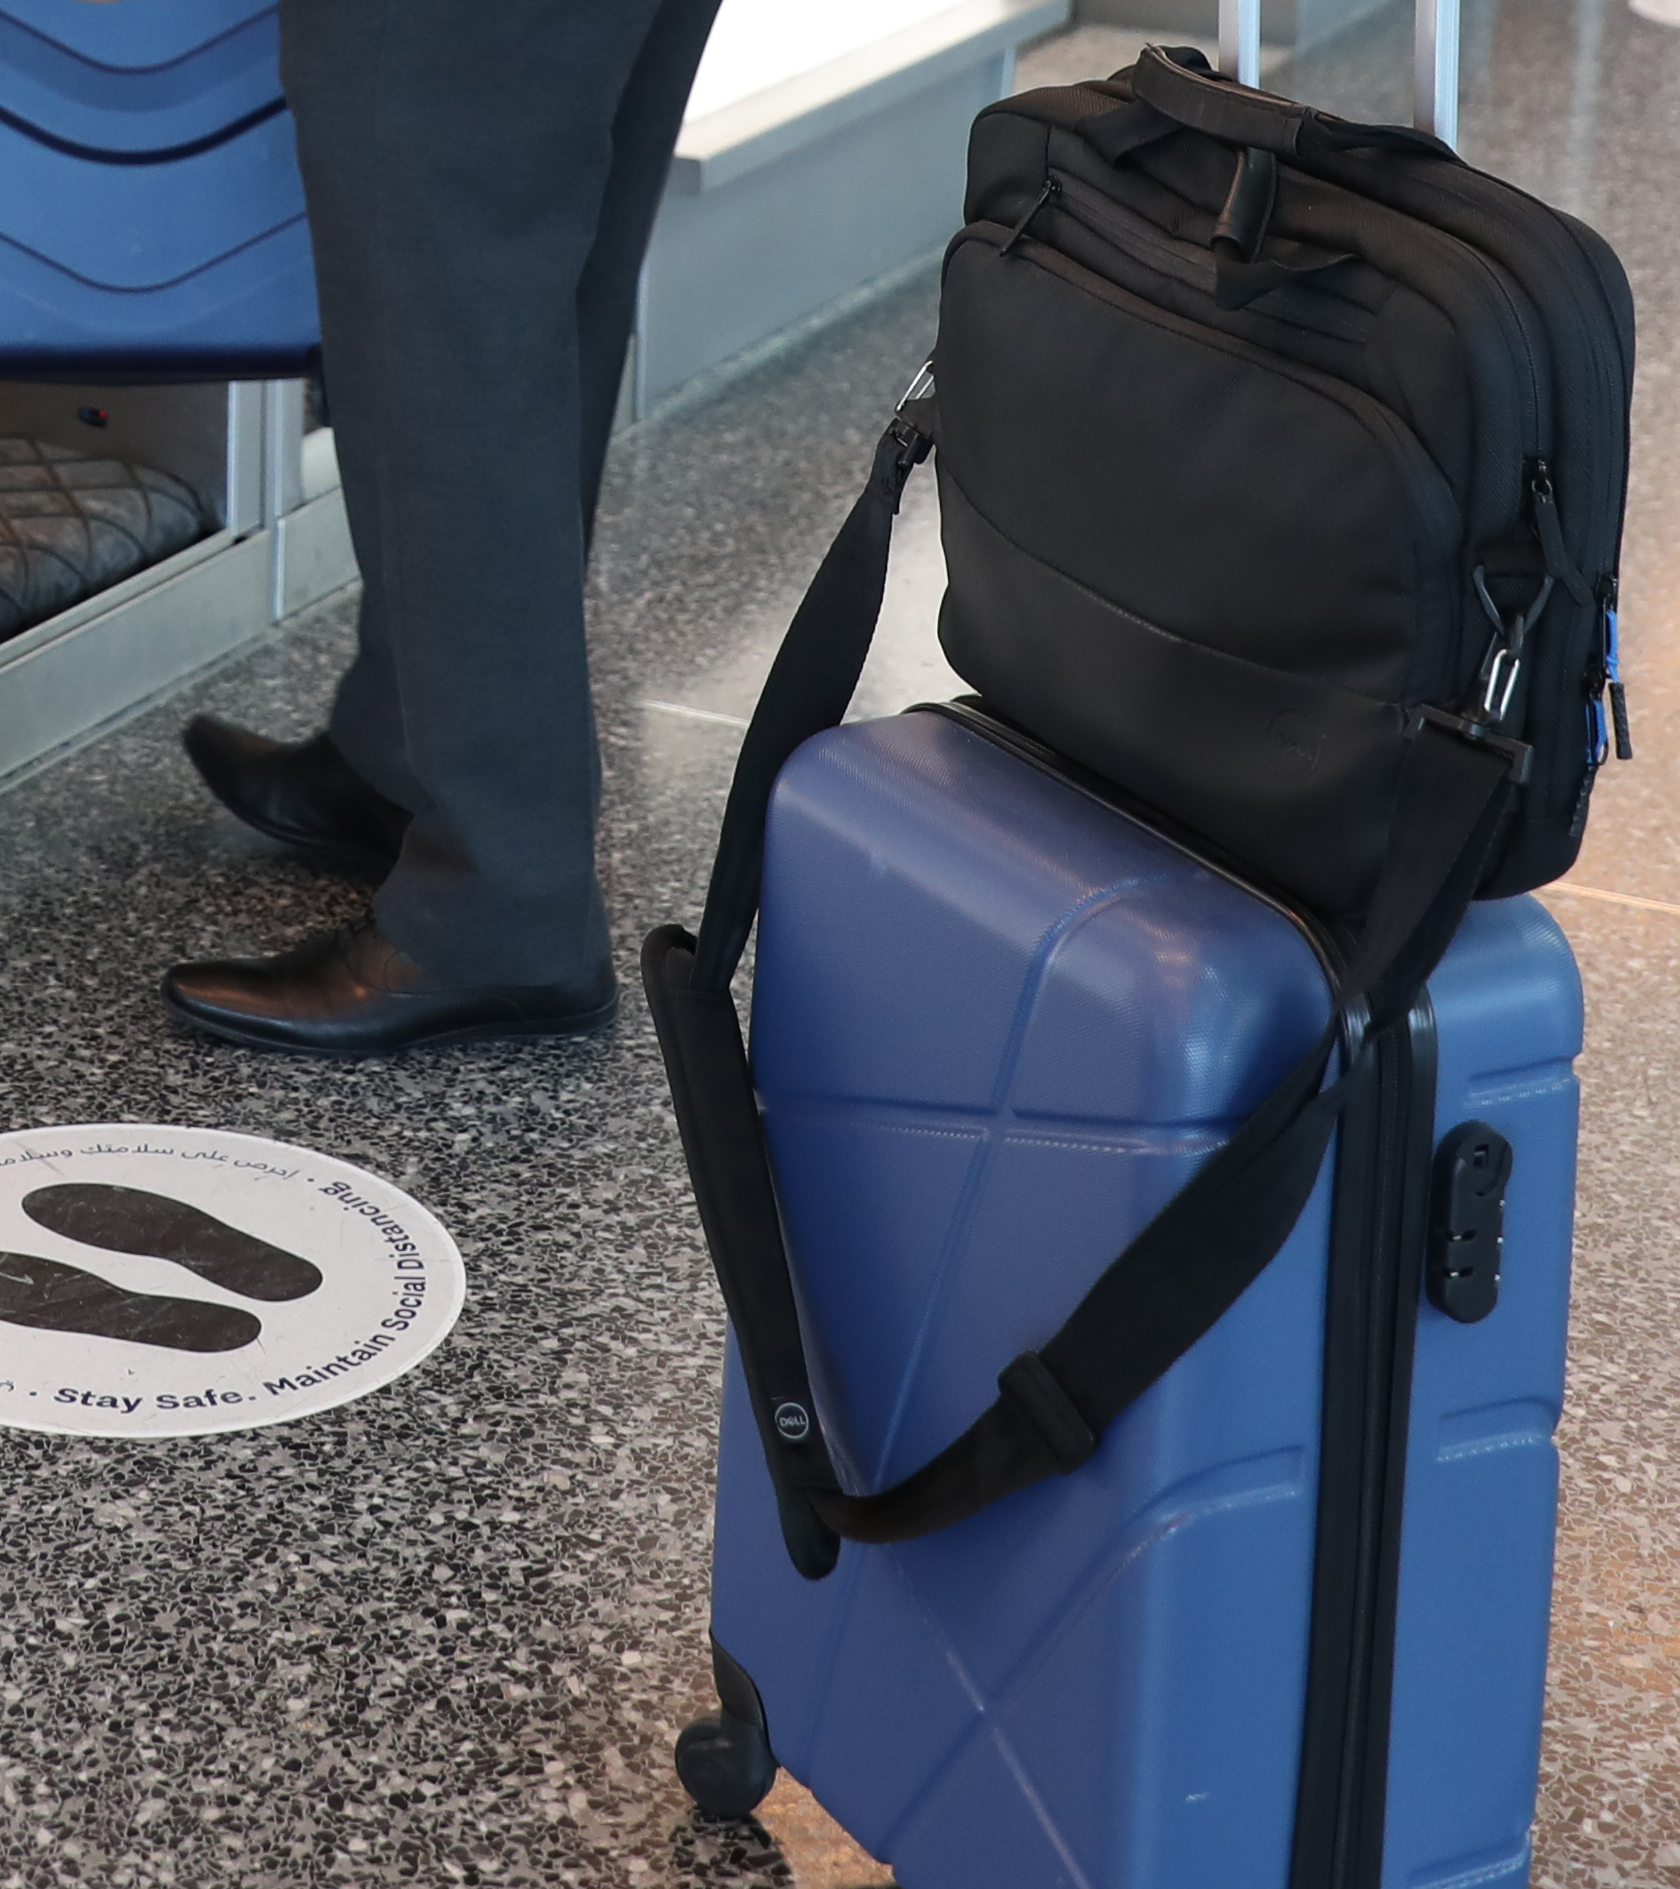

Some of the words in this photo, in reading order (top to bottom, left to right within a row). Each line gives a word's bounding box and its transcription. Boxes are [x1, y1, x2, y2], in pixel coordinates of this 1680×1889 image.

[79, 1143, 175, 1156] سلامتك
[180, 1150, 229, 1162] على
[317, 1180, 425, 1271] Distancing
[380, 1275, 427, 1332] Social
[261, 1333, 397, 1397] Maintain
[53, 1387, 144, 1415] Stay
[155, 1388, 257, 1410] Safe.
[778, 1415, 806, 1427] DELL
